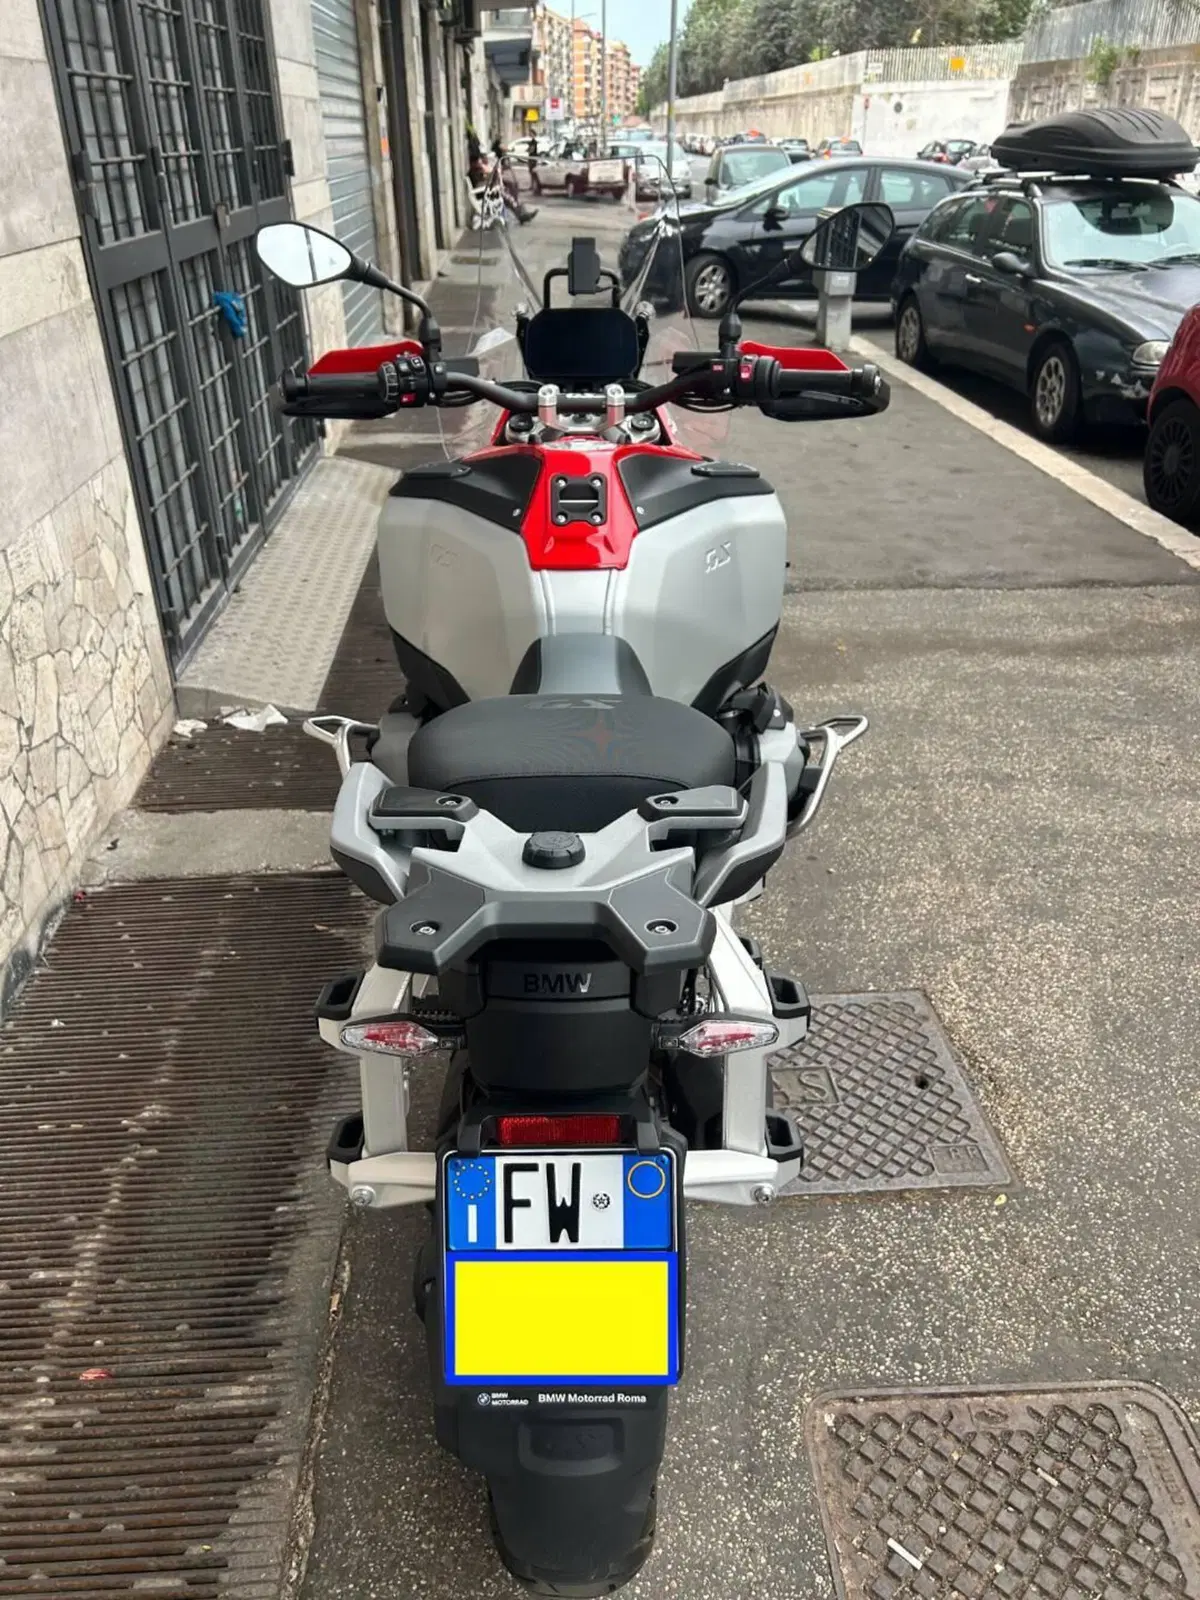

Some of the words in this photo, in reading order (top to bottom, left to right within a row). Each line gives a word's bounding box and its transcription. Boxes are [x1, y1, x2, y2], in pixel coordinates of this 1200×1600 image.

[523, 972, 592, 993] BMW
[503, 1163, 581, 1243] FW
[538, 1393, 566, 1403] BMW
[567, 1393, 615, 1403] Motorrad
[617, 1393, 647, 1403] Roma
